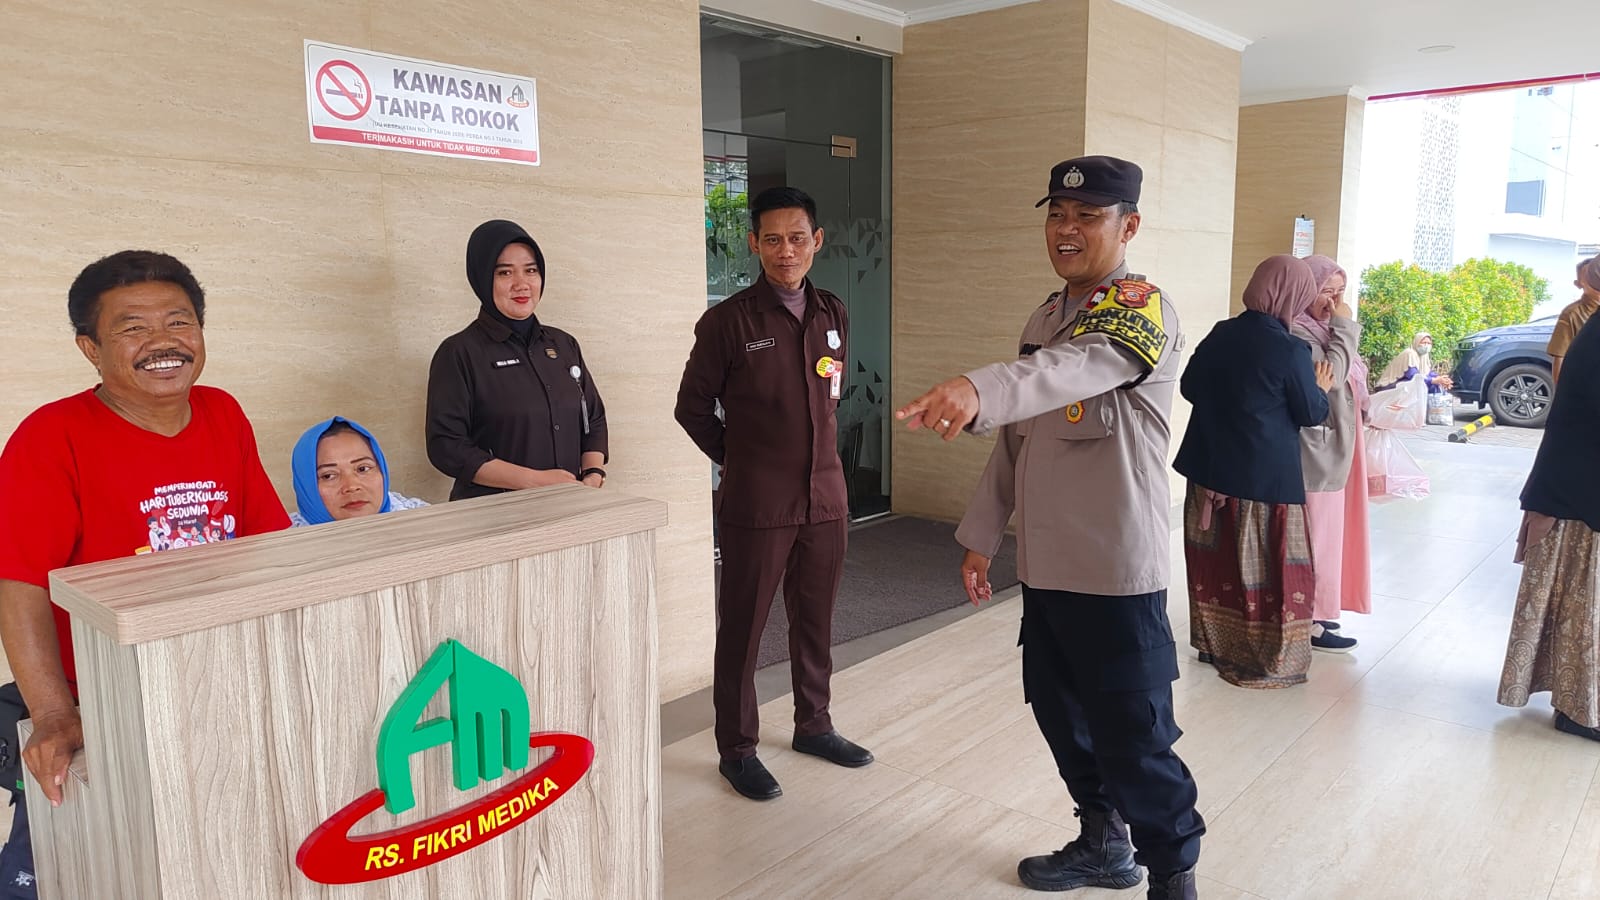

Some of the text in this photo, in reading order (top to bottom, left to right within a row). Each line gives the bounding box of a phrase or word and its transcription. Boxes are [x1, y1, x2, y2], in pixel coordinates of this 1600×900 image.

[393, 68, 502, 104] KAWASAN
[375, 94, 520, 132] TANPA ROKOK
[361, 132, 501, 156] TERIMAKASIH UNTUK TIDAK MEROKOK
[154, 481, 217, 496] MEMPERINGATI
[140, 496, 167, 514] HARI
[167, 504, 210, 520] SEDUNIA
[364, 776, 560, 871] RS. FIKRI MEDIKA
